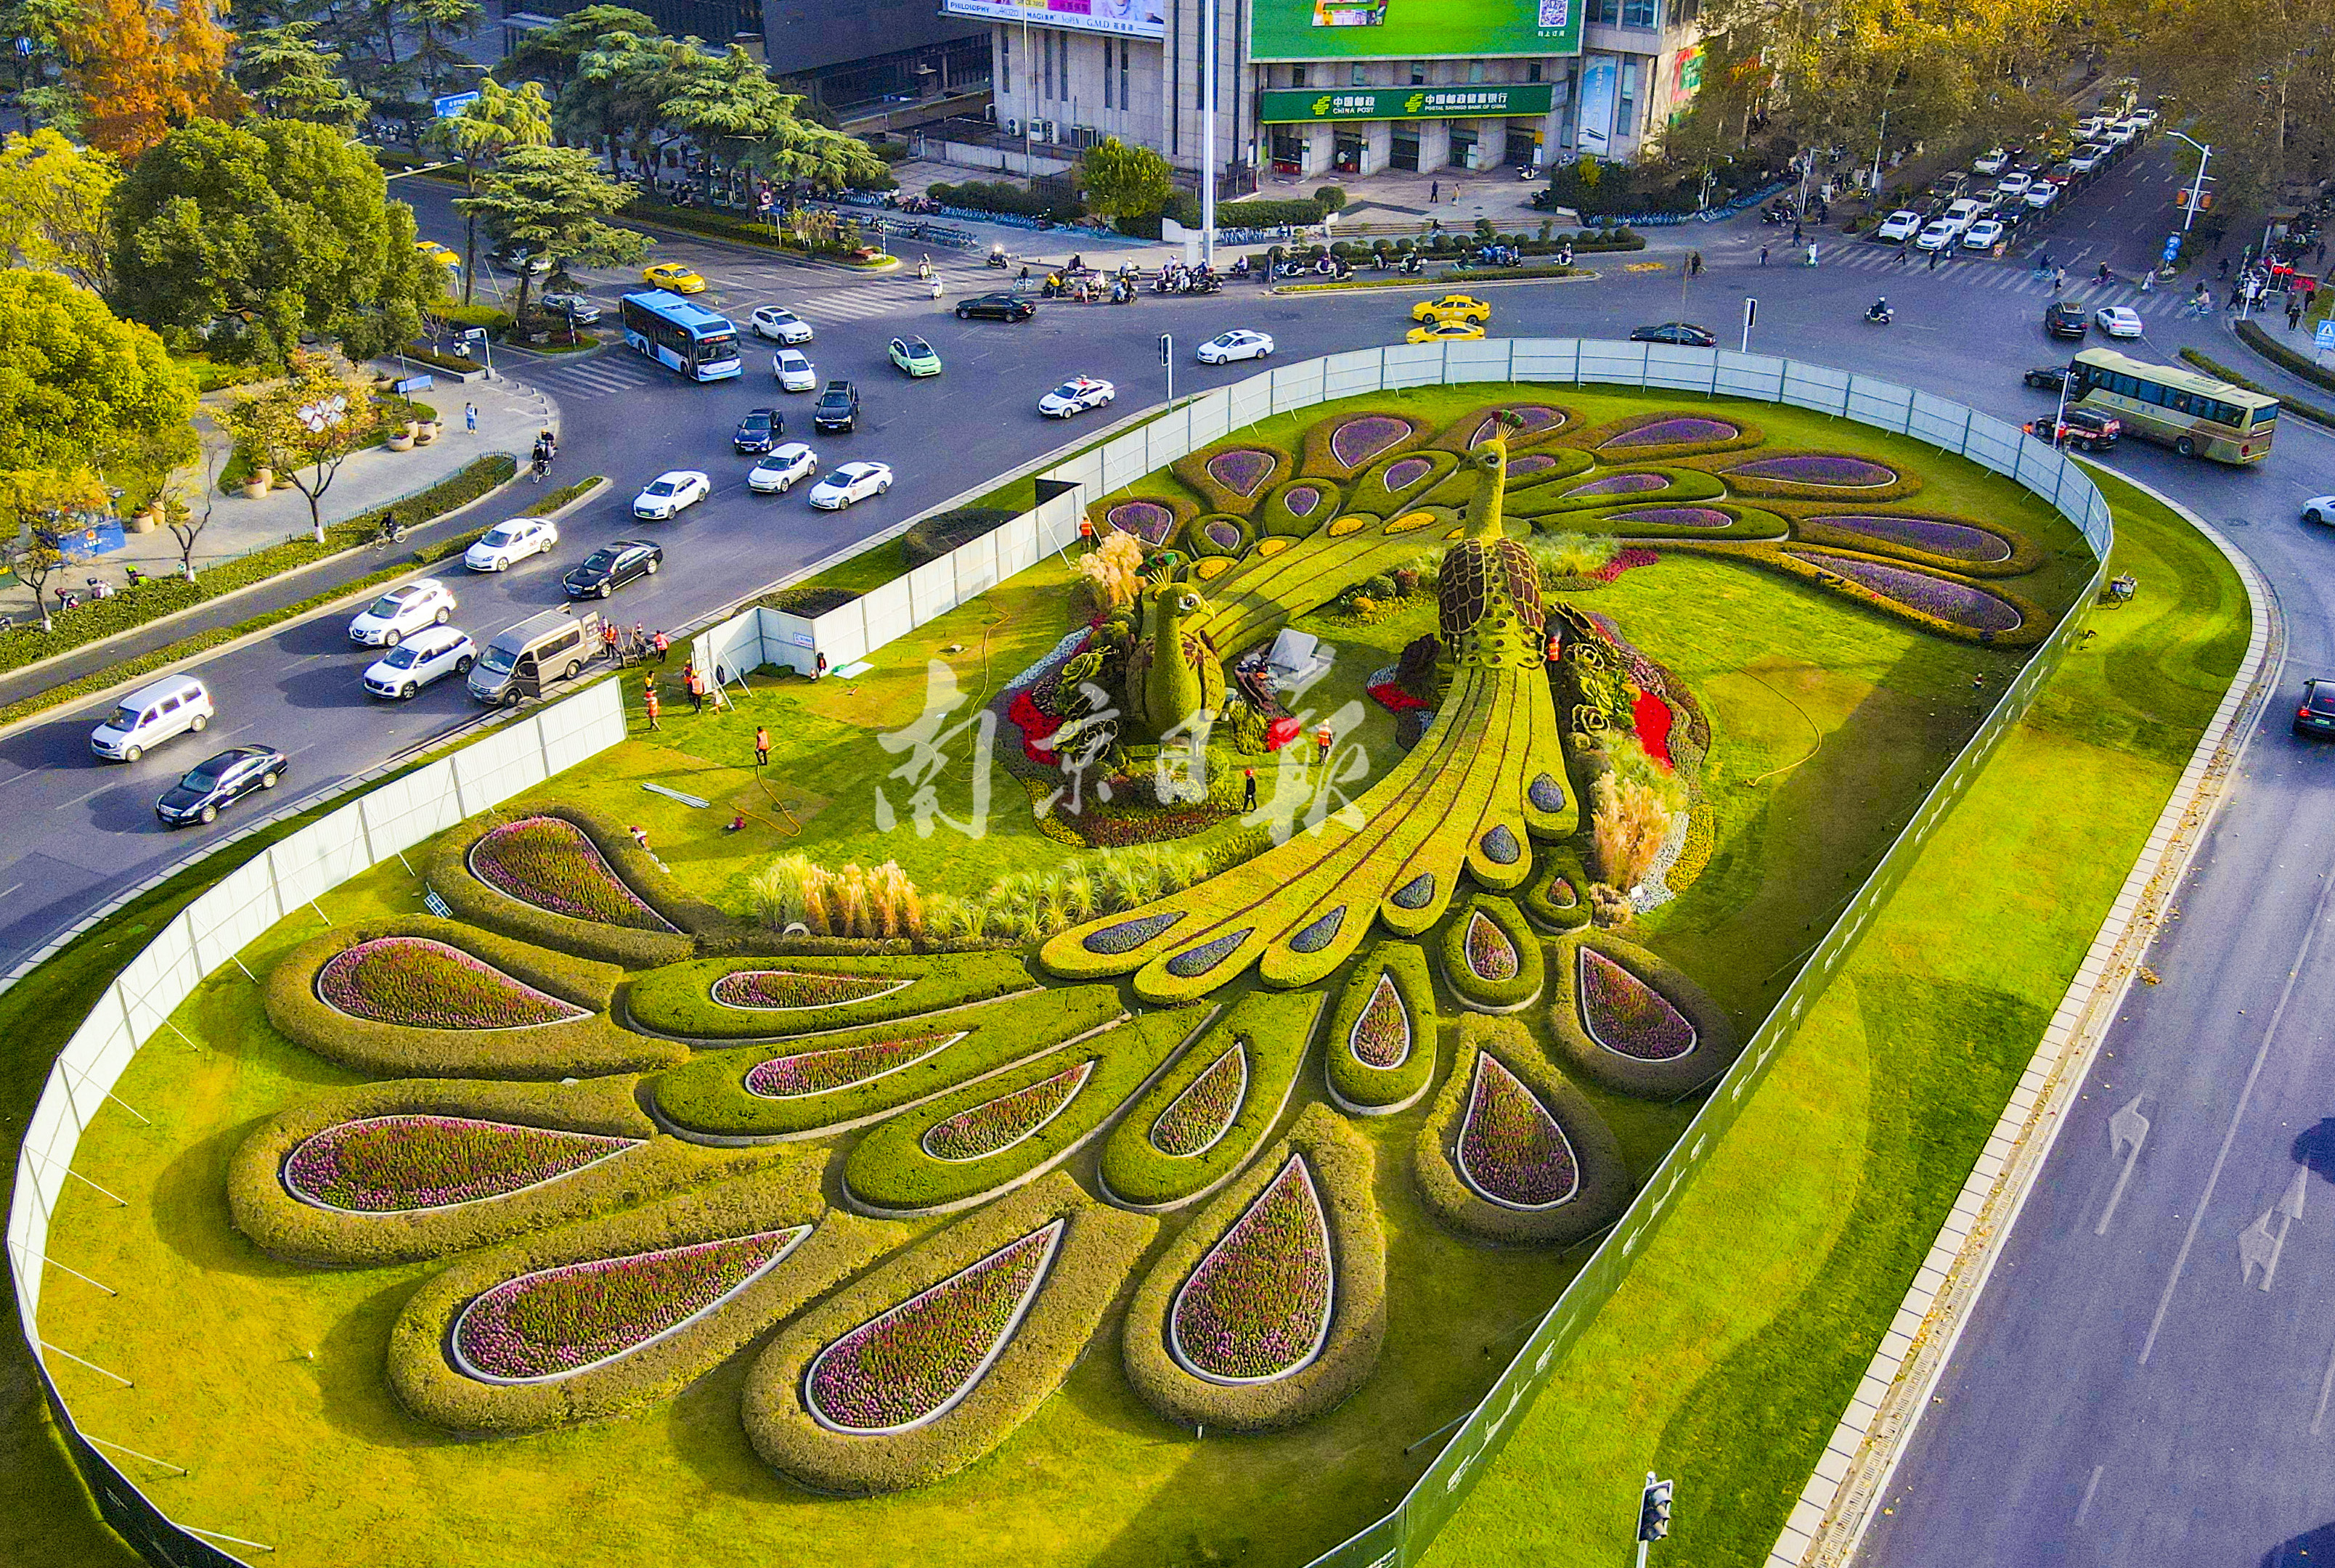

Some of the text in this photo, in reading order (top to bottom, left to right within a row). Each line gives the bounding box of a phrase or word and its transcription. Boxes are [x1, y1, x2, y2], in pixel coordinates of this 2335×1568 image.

[1333, 96, 1375, 107] 中国邮政
[1425, 92, 1507, 105] 中国邮政储蓄银行
